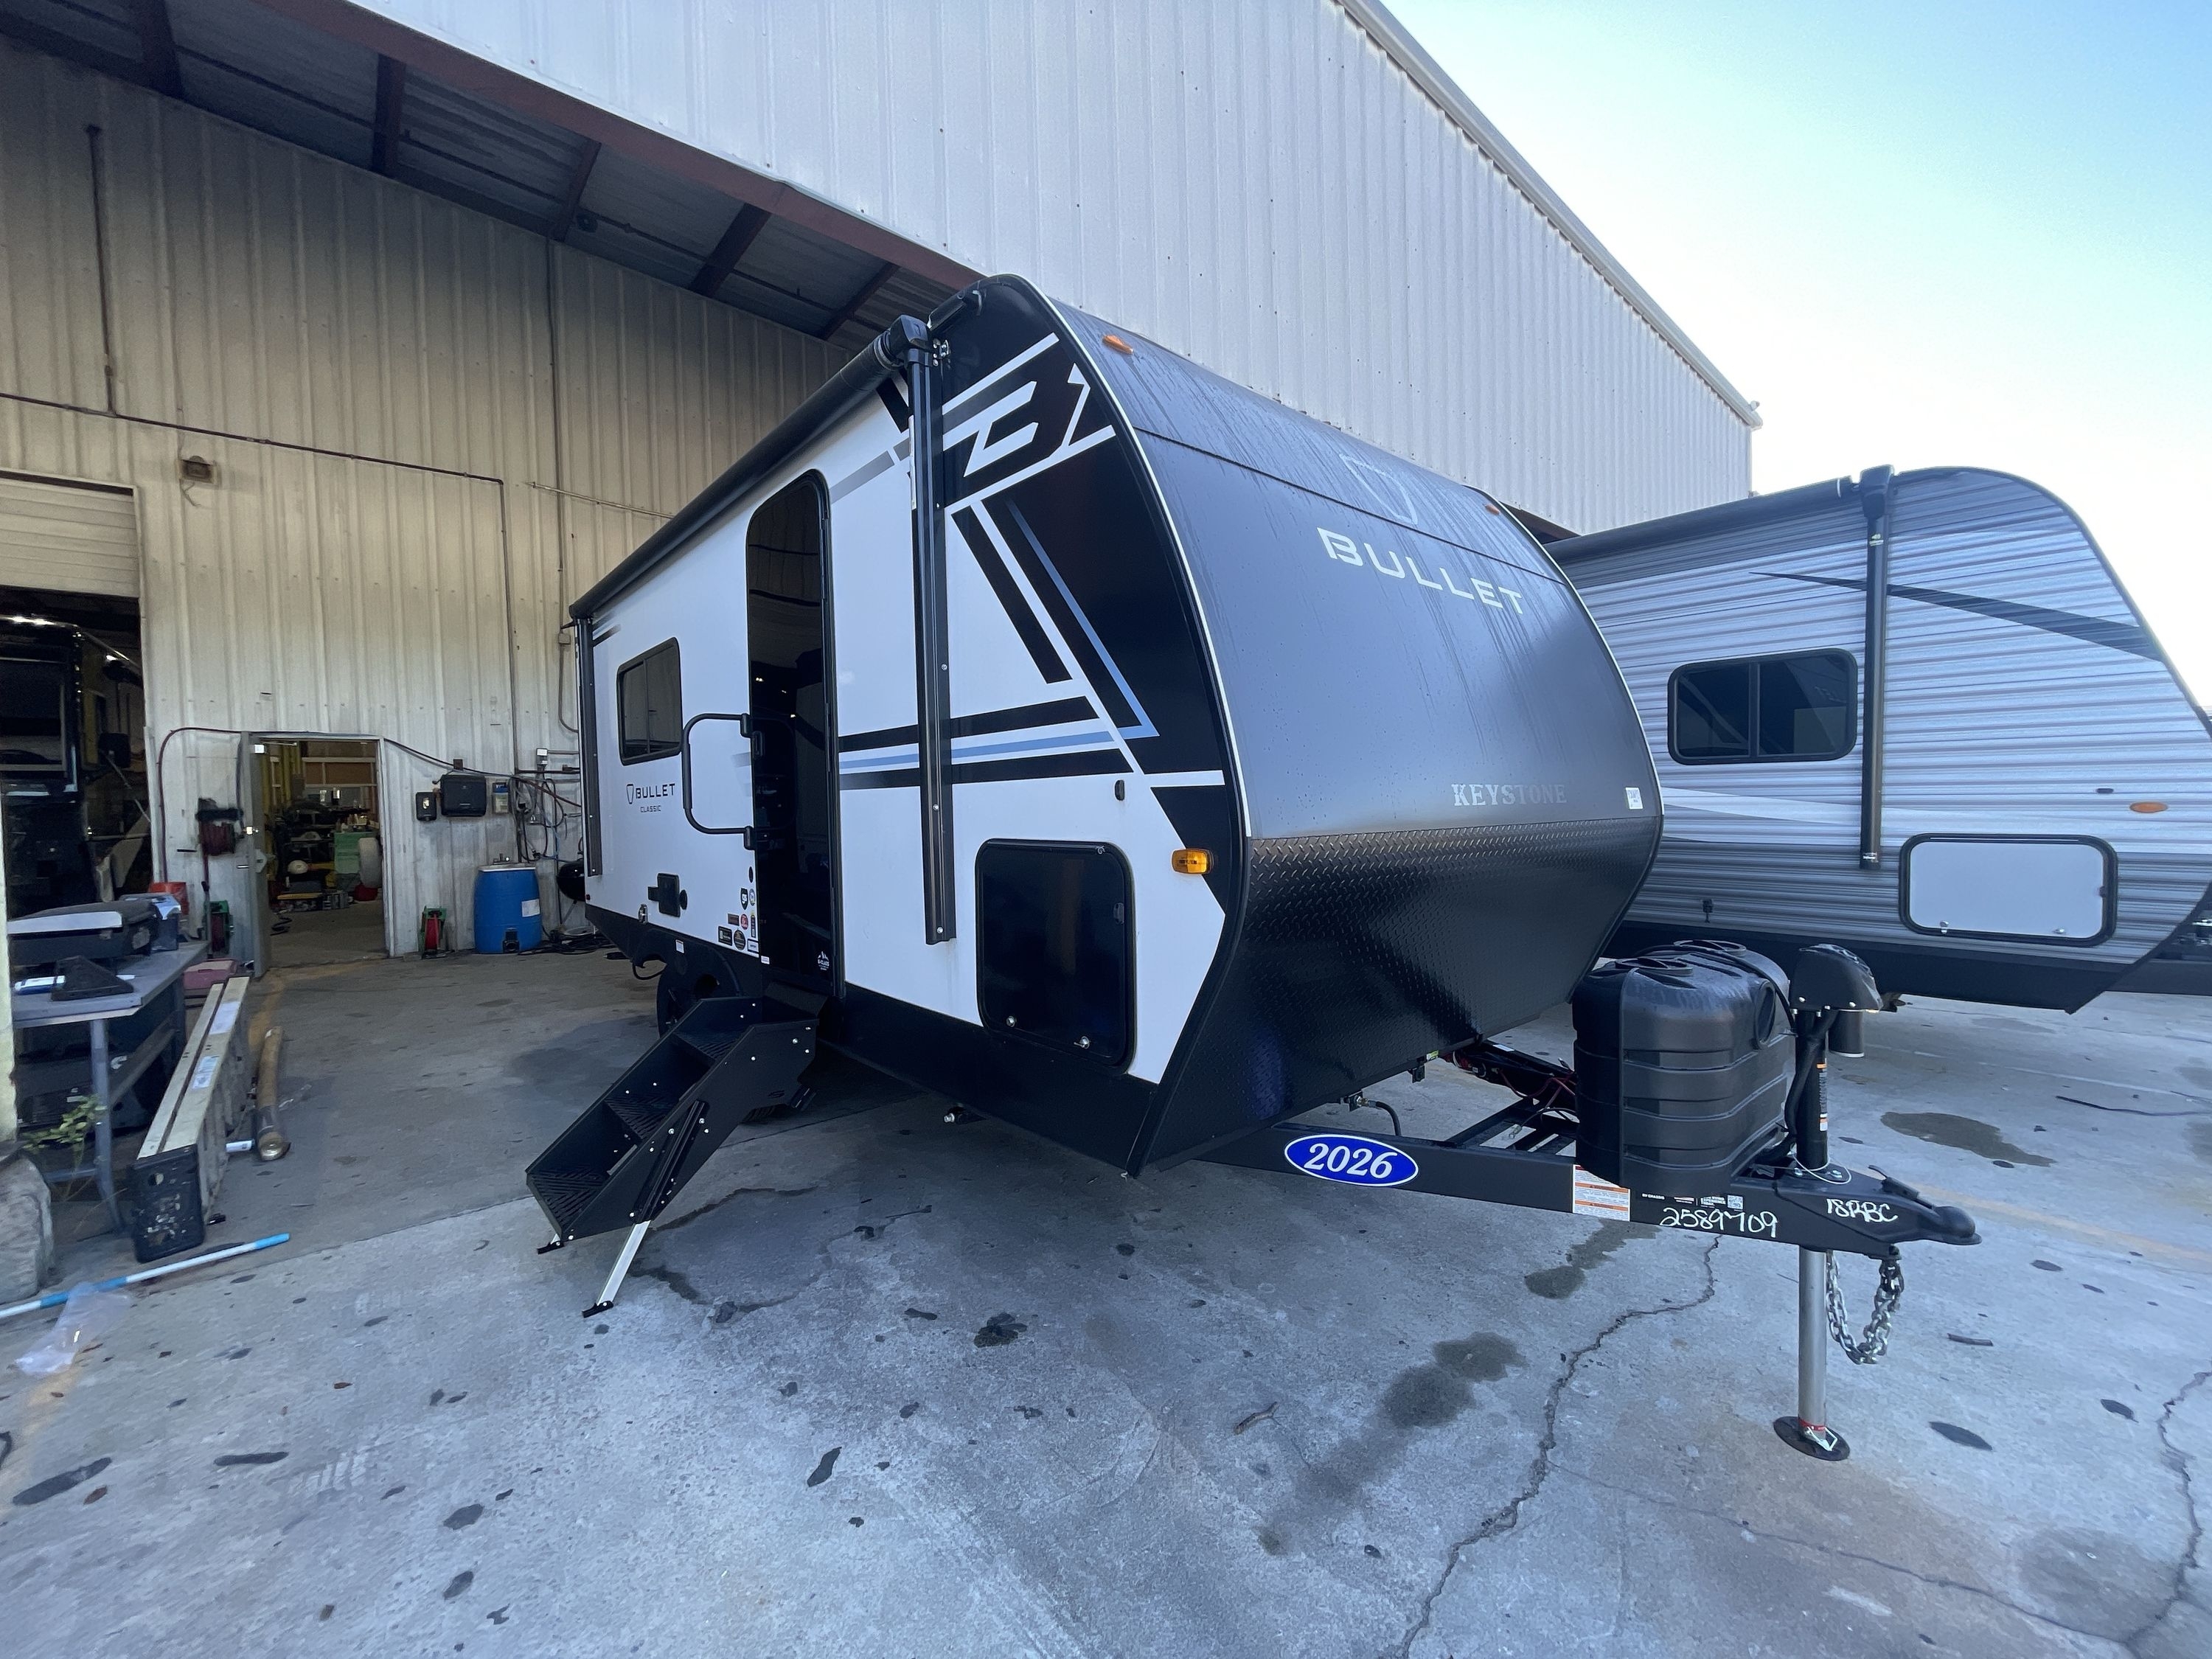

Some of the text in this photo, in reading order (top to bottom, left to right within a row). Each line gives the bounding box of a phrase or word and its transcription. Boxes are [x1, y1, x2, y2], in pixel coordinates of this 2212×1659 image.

[1316, 526, 1523, 615] BULLET
[636, 783, 675, 799] BULLET
[1451, 783, 1568, 807] KEYSTONE
[1303, 1143, 1398, 1179] 2026
[1659, 1207, 1778, 1238] 2589709
